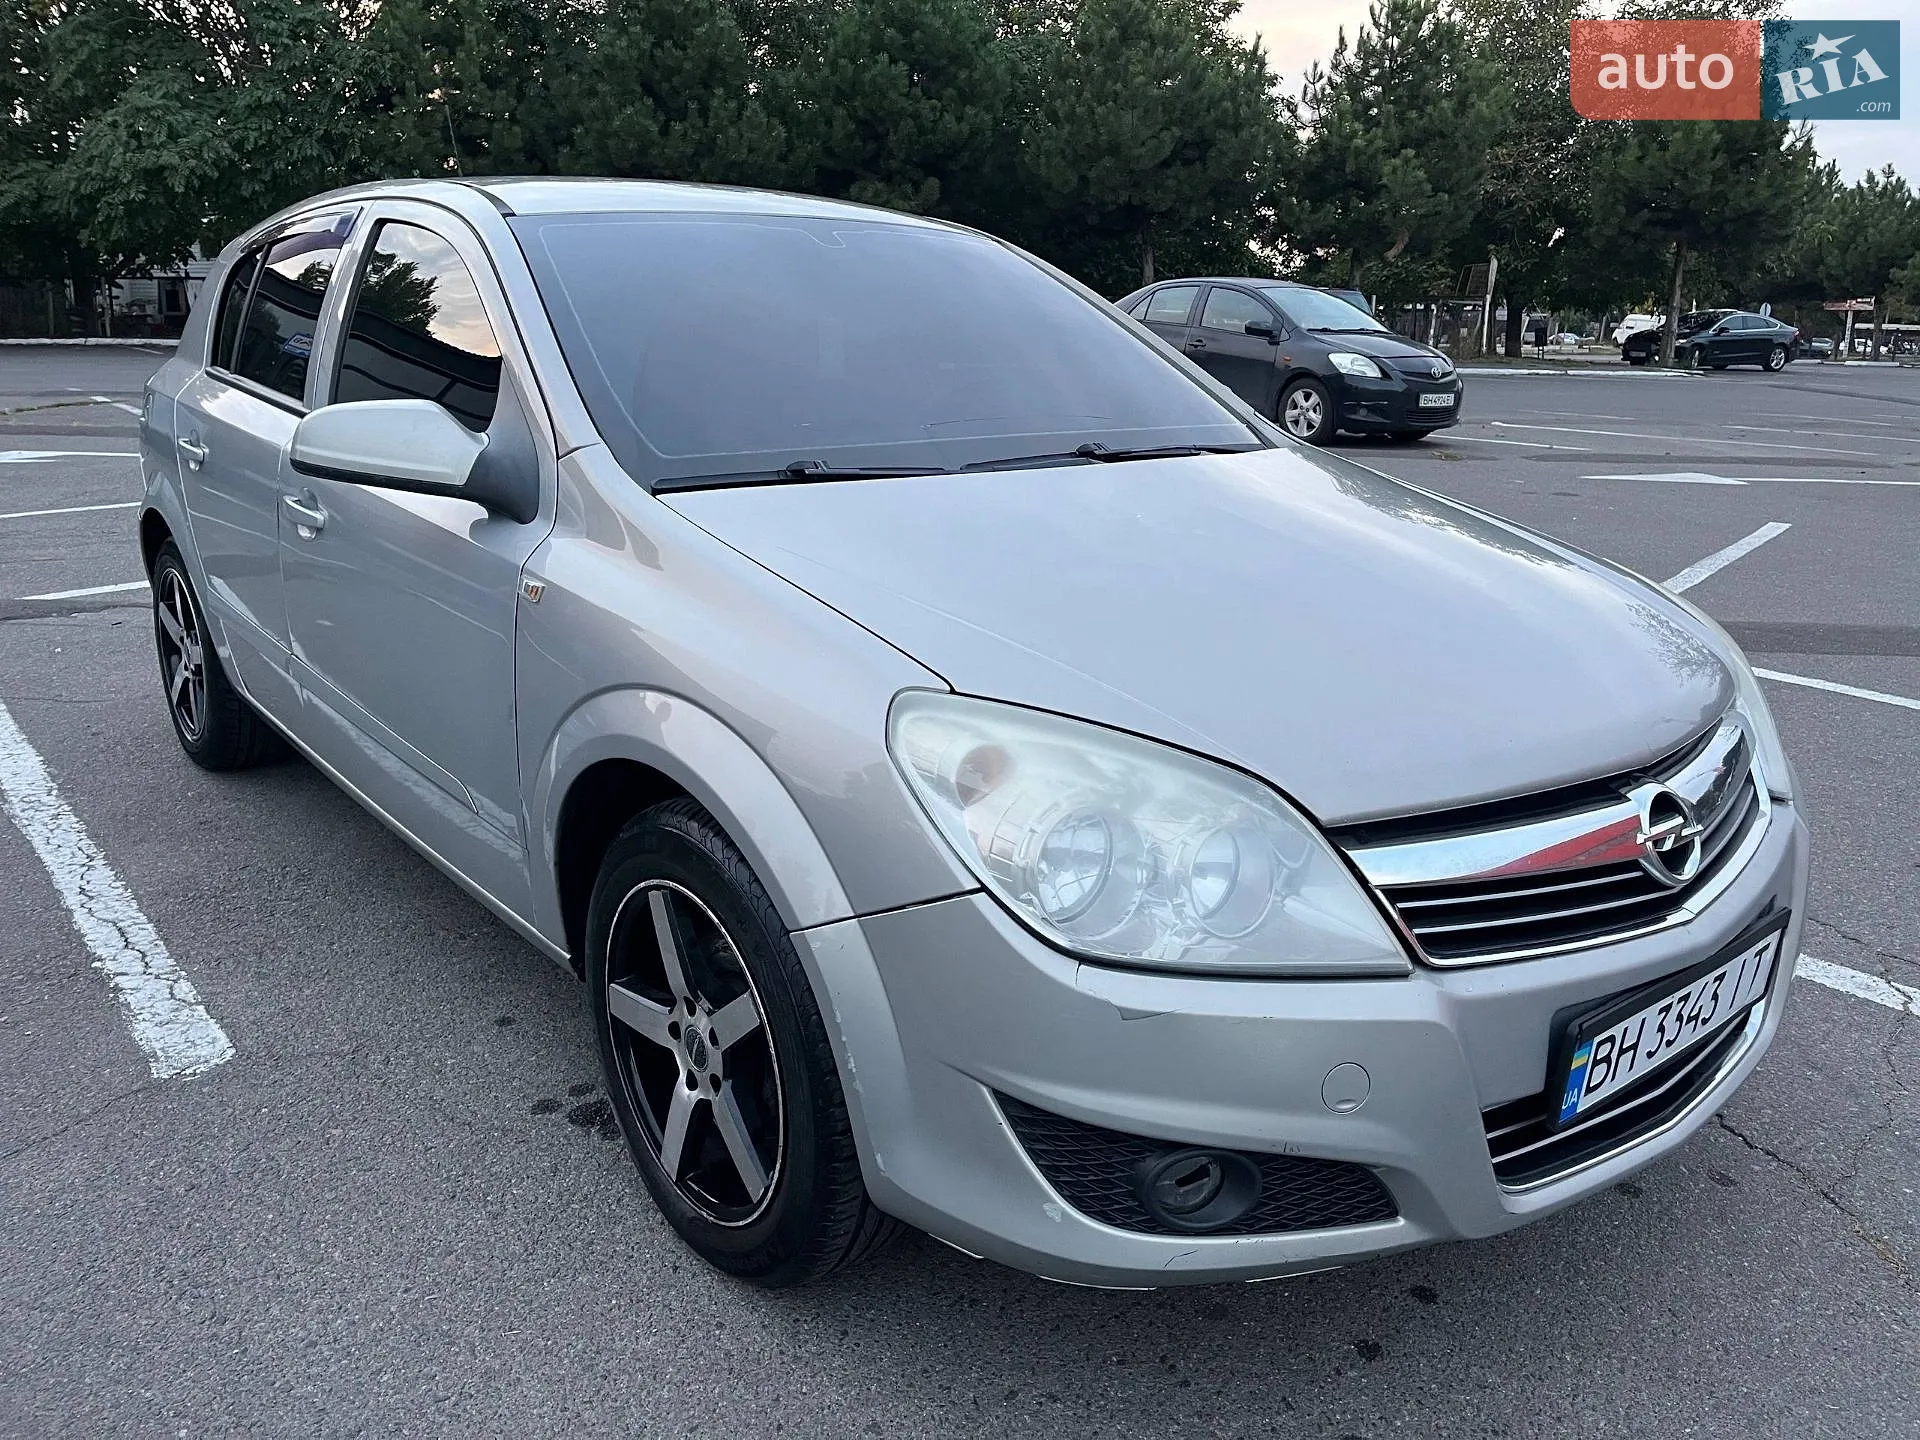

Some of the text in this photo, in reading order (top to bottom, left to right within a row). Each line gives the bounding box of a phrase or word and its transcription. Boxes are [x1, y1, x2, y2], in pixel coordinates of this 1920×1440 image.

[1583, 941, 1772, 1098] BH 3343 IT
[1561, 1090, 1578, 1110] UA
